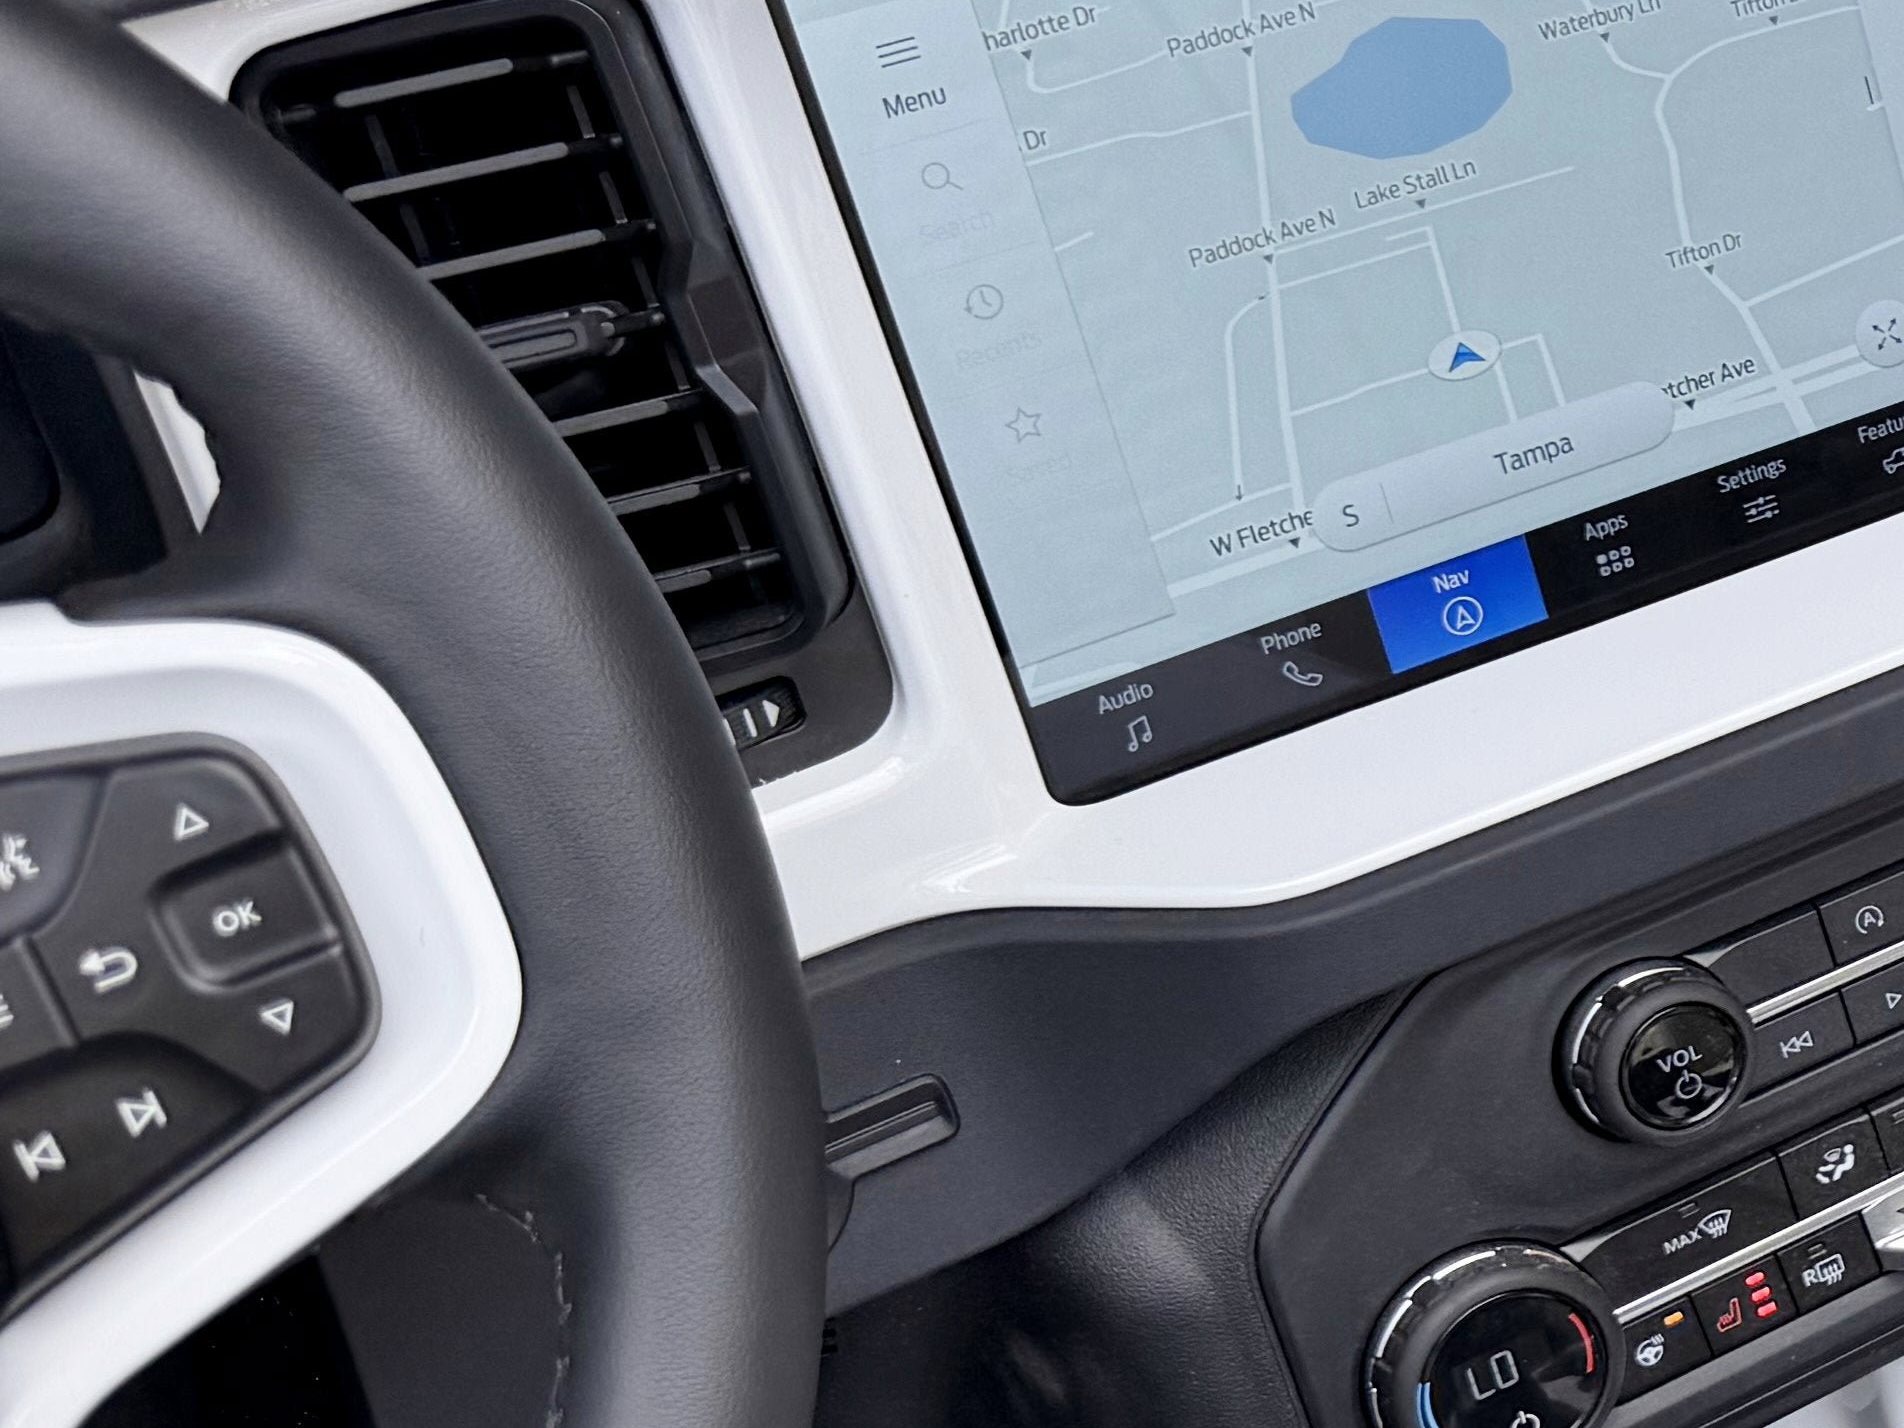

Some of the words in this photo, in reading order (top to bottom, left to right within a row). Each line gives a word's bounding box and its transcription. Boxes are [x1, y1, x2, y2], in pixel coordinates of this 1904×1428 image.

[982, 15, 1070, 52] harlotte
[1073, 5, 1097, 29] Dr
[1167, 20, 1256, 59] Paddock
[1258, 9, 1297, 34] Ave
[1298, 2, 1317, 22] N
[1538, 4, 1636, 42] Waterbury
[883, 87, 946, 120] Menu
[1025, 129, 1048, 151] Dr
[1355, 182, 1400, 210] Lake
[1403, 166, 1449, 197] Stall
[1452, 159, 1477, 183] Ln
[1189, 229, 1275, 268] Paddock
[1279, 219, 1315, 244] Ave
[1319, 209, 1337, 230] N
[1666, 241, 1720, 270] Tifton
[1722, 232, 1744, 256] Dr
[1719, 357, 1756, 383] Ave
[1494, 434, 1574, 475] Tampa
[1717, 456, 1787, 494] Settings
[1343, 504, 1359, 527] S
[1584, 513, 1629, 542] Apps
[1210, 535, 1234, 557] W
[1433, 568, 1470, 593] Nav
[1261, 620, 1323, 655] Phone
[1098, 680, 1154, 714] Audio
[212, 900, 261, 937] OK
[1656, 1045, 1702, 1070] VOL
[1663, 1228, 1703, 1254] MAX
